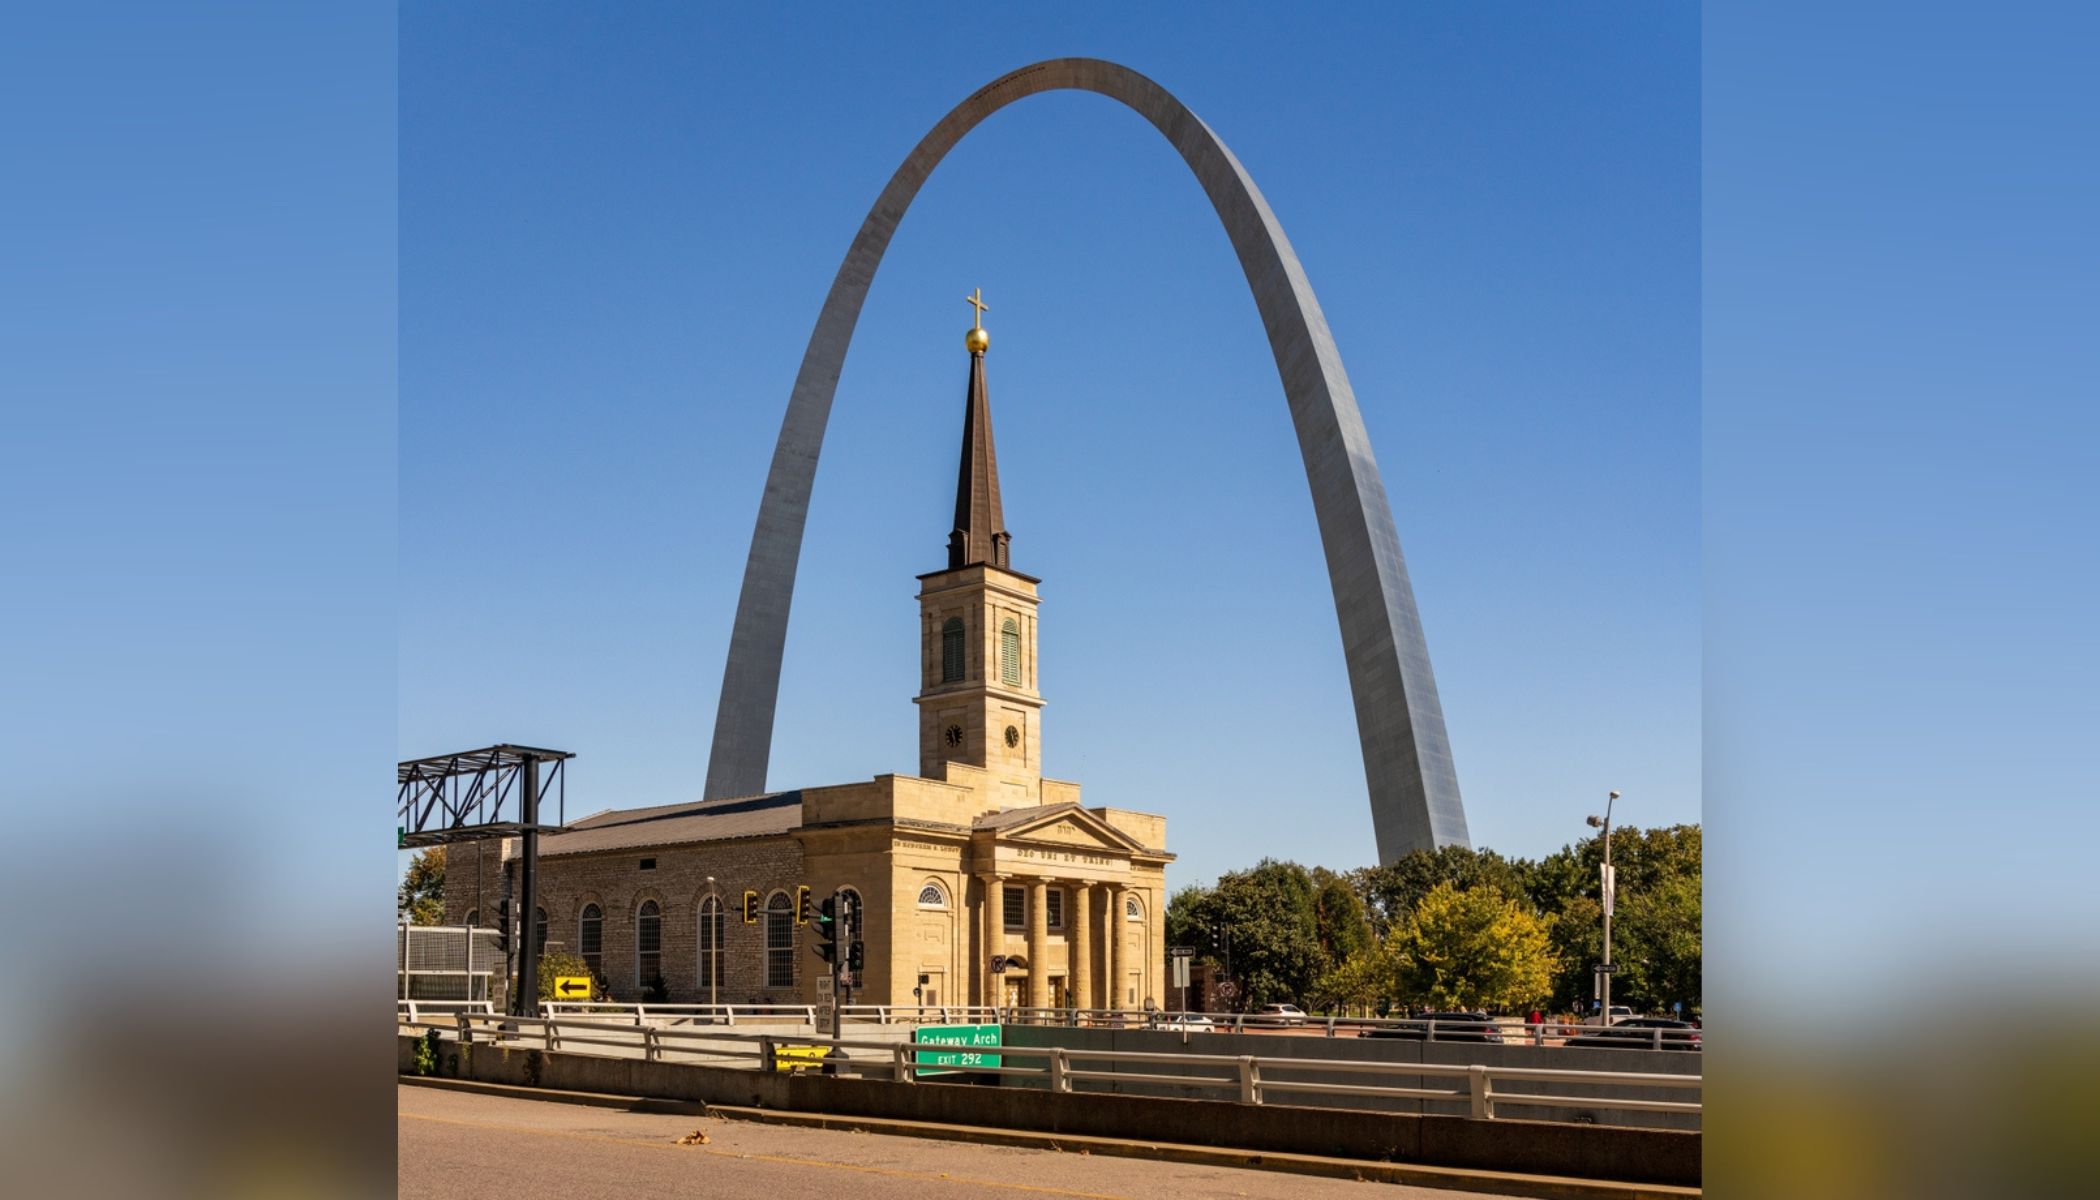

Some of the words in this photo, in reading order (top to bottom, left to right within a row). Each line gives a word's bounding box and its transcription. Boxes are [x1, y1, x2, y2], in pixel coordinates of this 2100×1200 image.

[1017, 848, 1034, 858] DEO
[921, 1035, 967, 1046] Gateway
[973, 1032, 997, 1045] Arch
[937, 1055, 956, 1065] EXIT
[961, 1053, 982, 1065] 292
